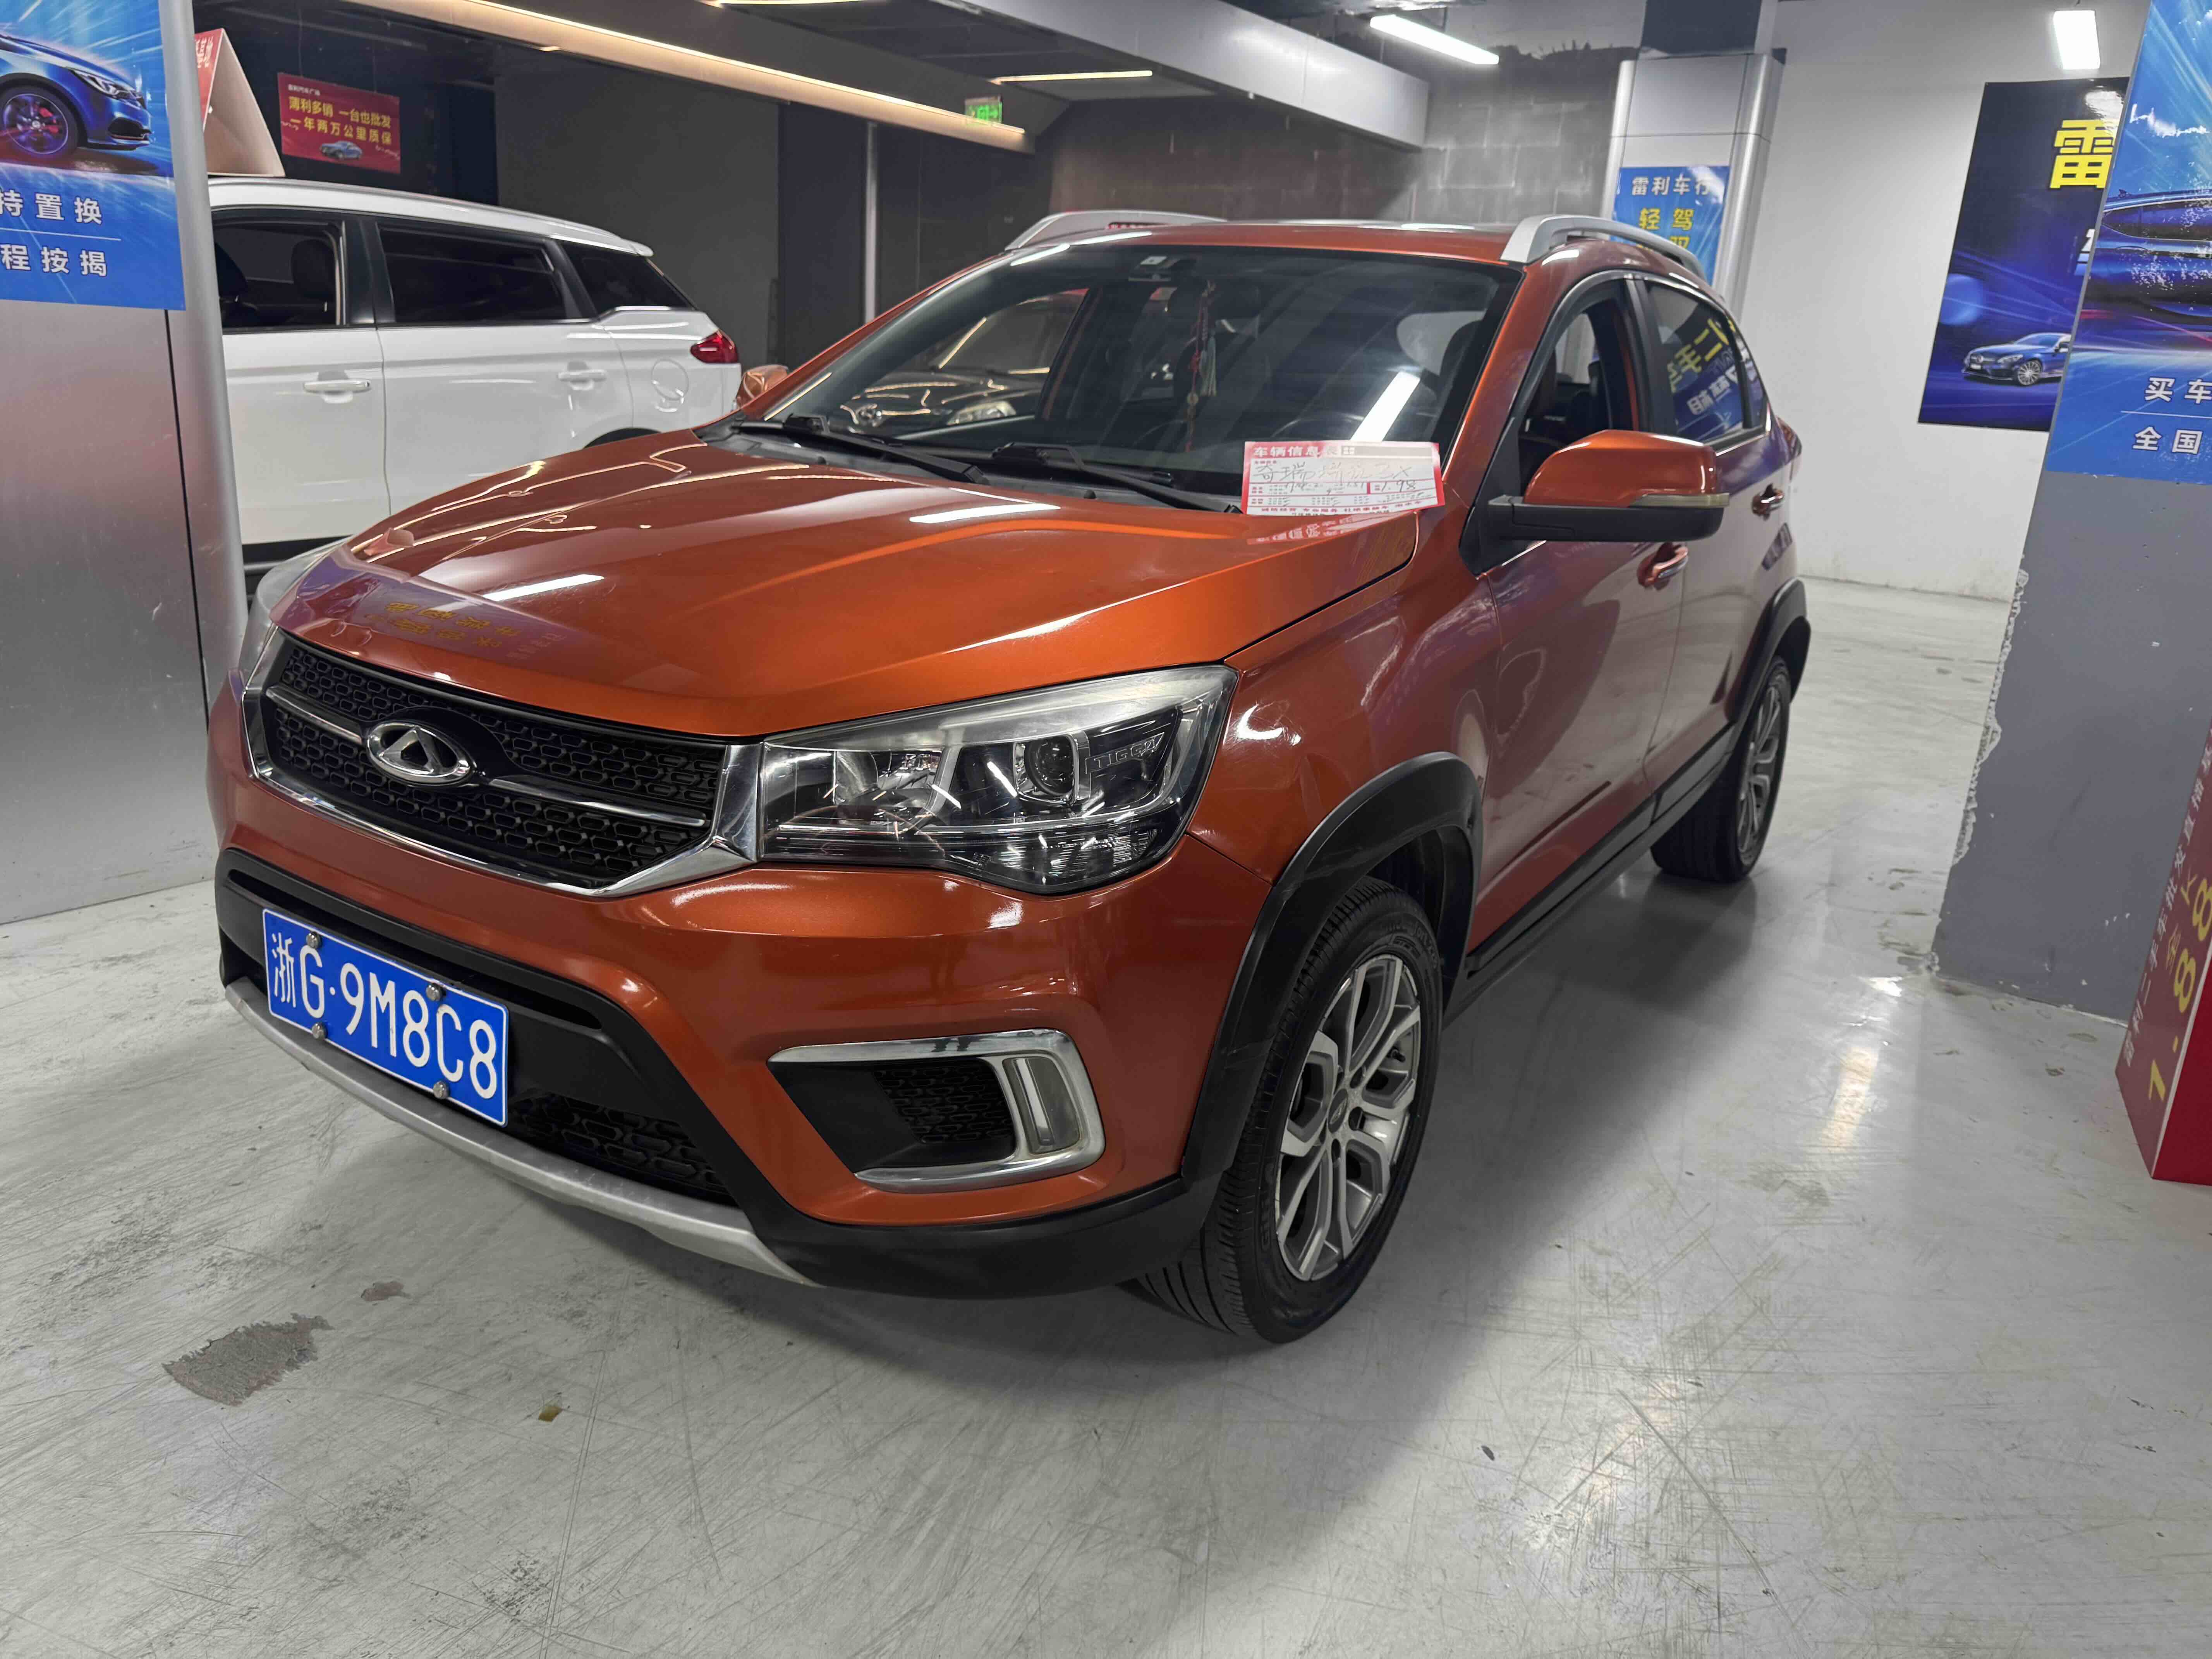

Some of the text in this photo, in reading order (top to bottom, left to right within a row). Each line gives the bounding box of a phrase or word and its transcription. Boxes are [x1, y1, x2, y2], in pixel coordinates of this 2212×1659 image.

[290, 96, 391, 128] 薄利多销 一台也批发
[290, 116, 391, 145] 一年两万公里质保
[2050, 120, 2116, 189] 雷
[1632, 173, 1710, 196] 雷利车行
[0, 190, 102, 225] 持置换
[1638, 208, 1695, 230] 轻驾
[0, 244, 107, 276] 程按揭
[2144, 377, 2212, 404] 买车
[2132, 426, 2203, 454] 全国
[272, 932, 497, 1099] 浙G·9M8C8
